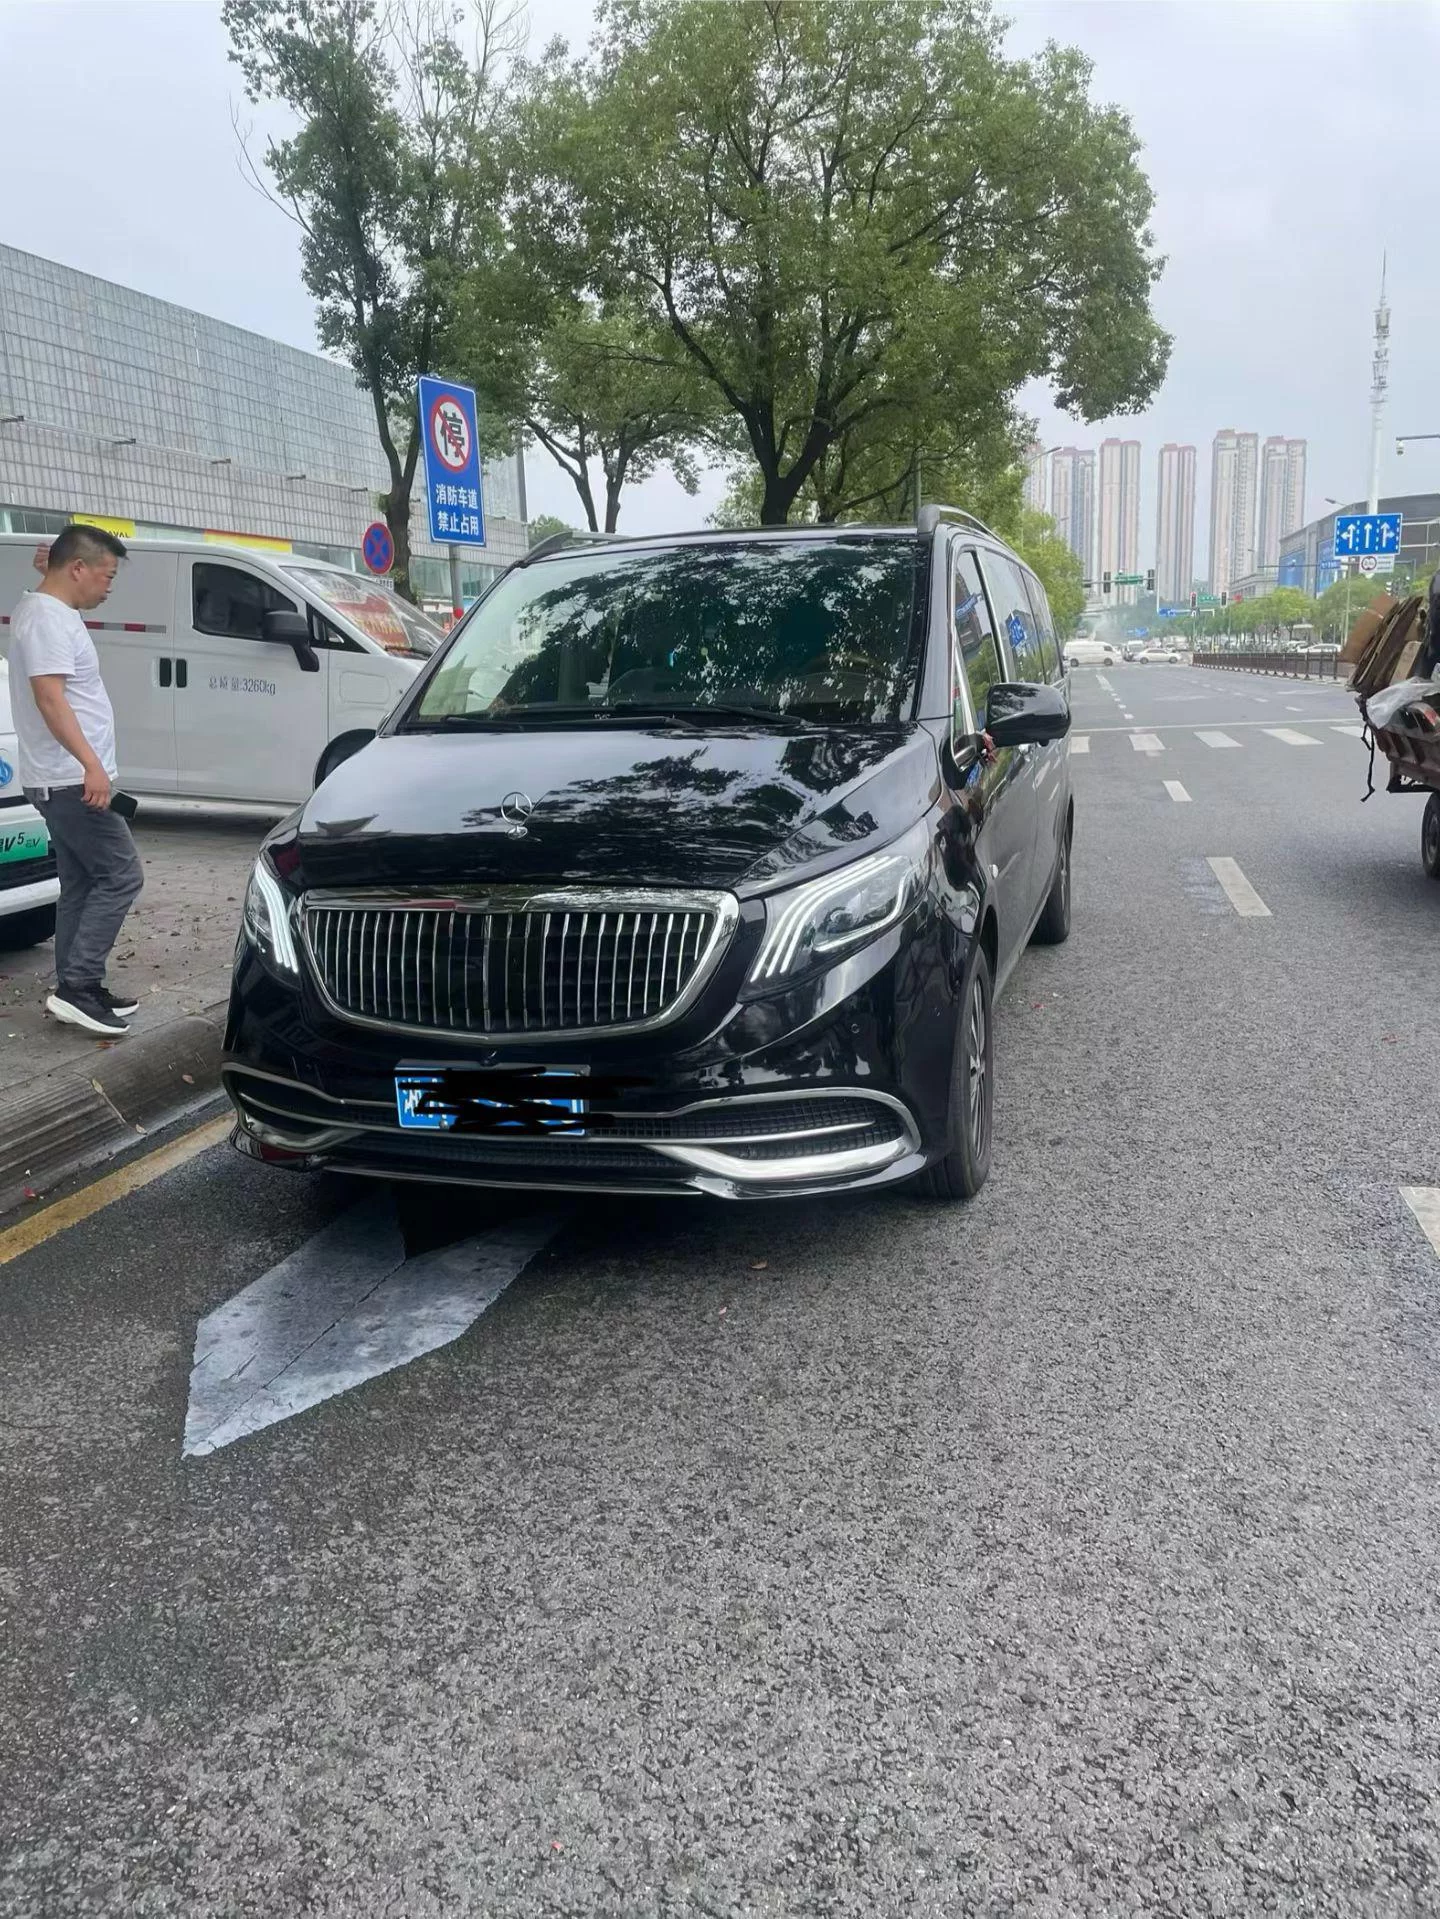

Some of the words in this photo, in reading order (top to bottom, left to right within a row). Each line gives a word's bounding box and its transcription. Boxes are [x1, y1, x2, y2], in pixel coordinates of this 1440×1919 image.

[440, 410, 465, 458] 停
[436, 483, 479, 510] 消防车道
[437, 511, 480, 536] 禁止占用
